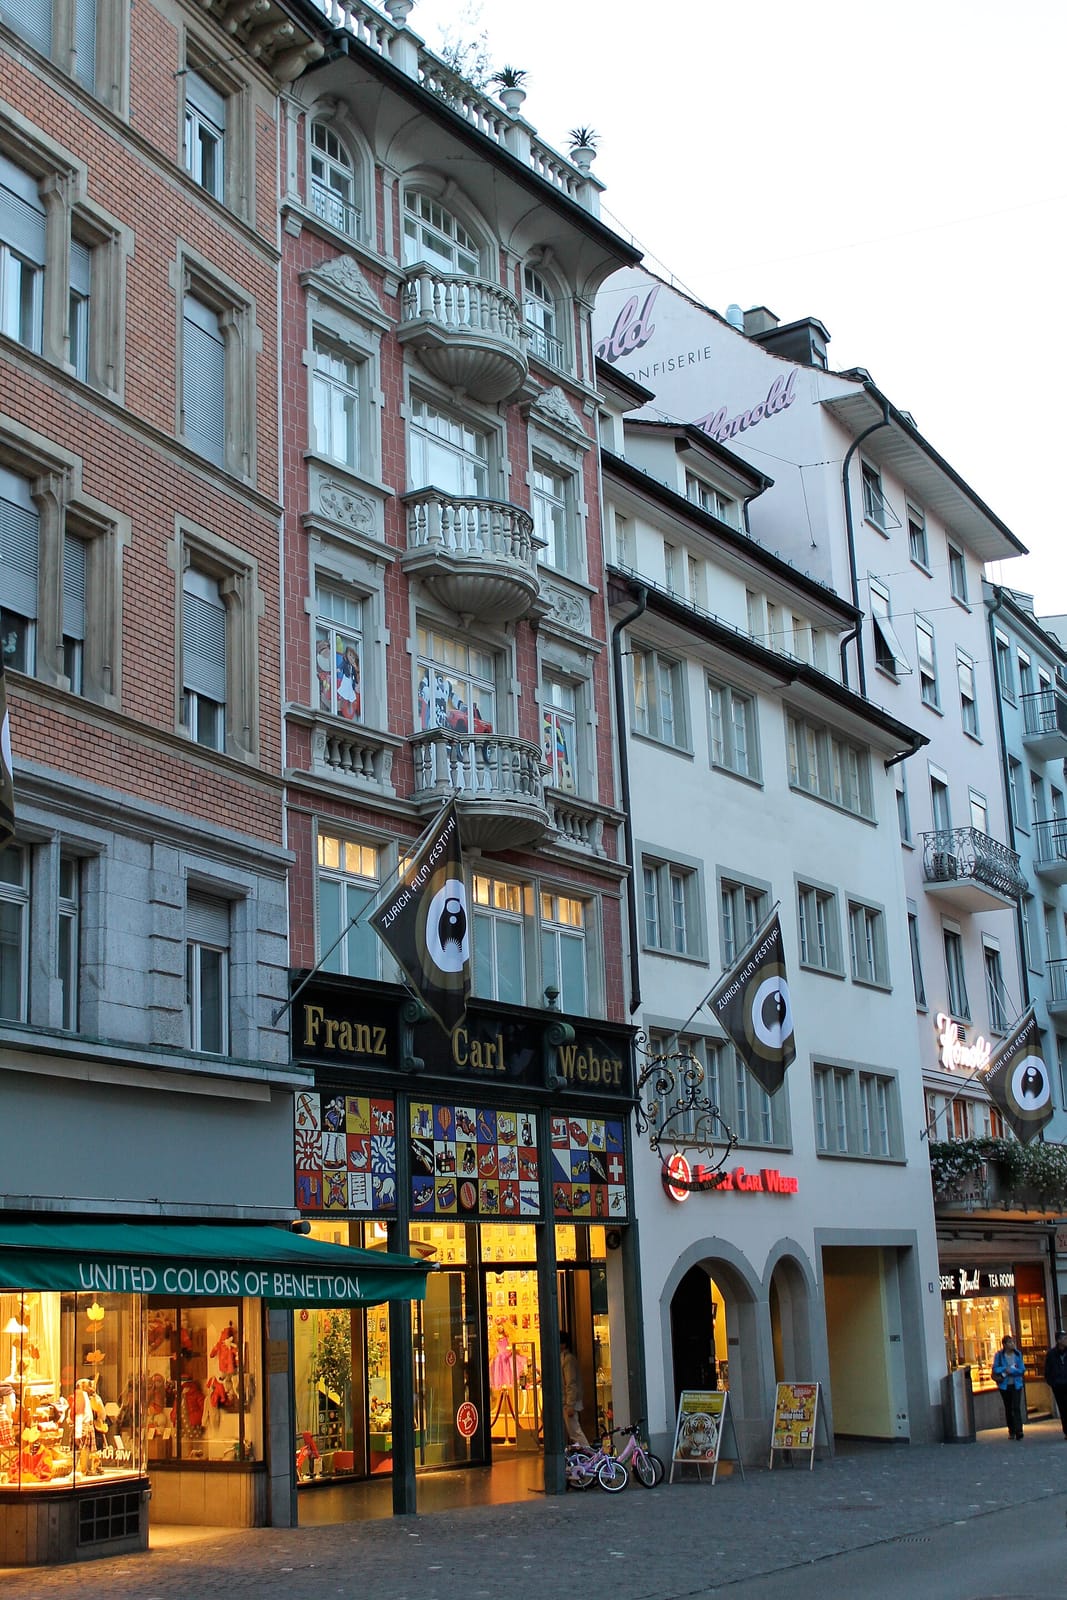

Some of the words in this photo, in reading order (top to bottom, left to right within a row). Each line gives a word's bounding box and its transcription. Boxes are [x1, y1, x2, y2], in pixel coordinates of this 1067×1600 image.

[381, 890, 412, 928] ZURICH
[410, 864, 431, 892] FILM
[716, 981, 741, 1010] ZURICH
[739, 962, 756, 983] FILM
[303, 1004, 387, 1056] Franz
[452, 1027, 507, 1071] Carl
[558, 1045, 623, 1084] Weber
[984, 1059, 1004, 1082] ZURICH
[1003, 1045, 1017, 1061] FILM
[79, 1263, 157, 1291] UNITED
[163, 1268, 239, 1294] COLORS
[244, 1271, 269, 1295] OF
[988, 1273, 999, 1288] TEA
[999, 1273, 1015, 1288] ROOM
